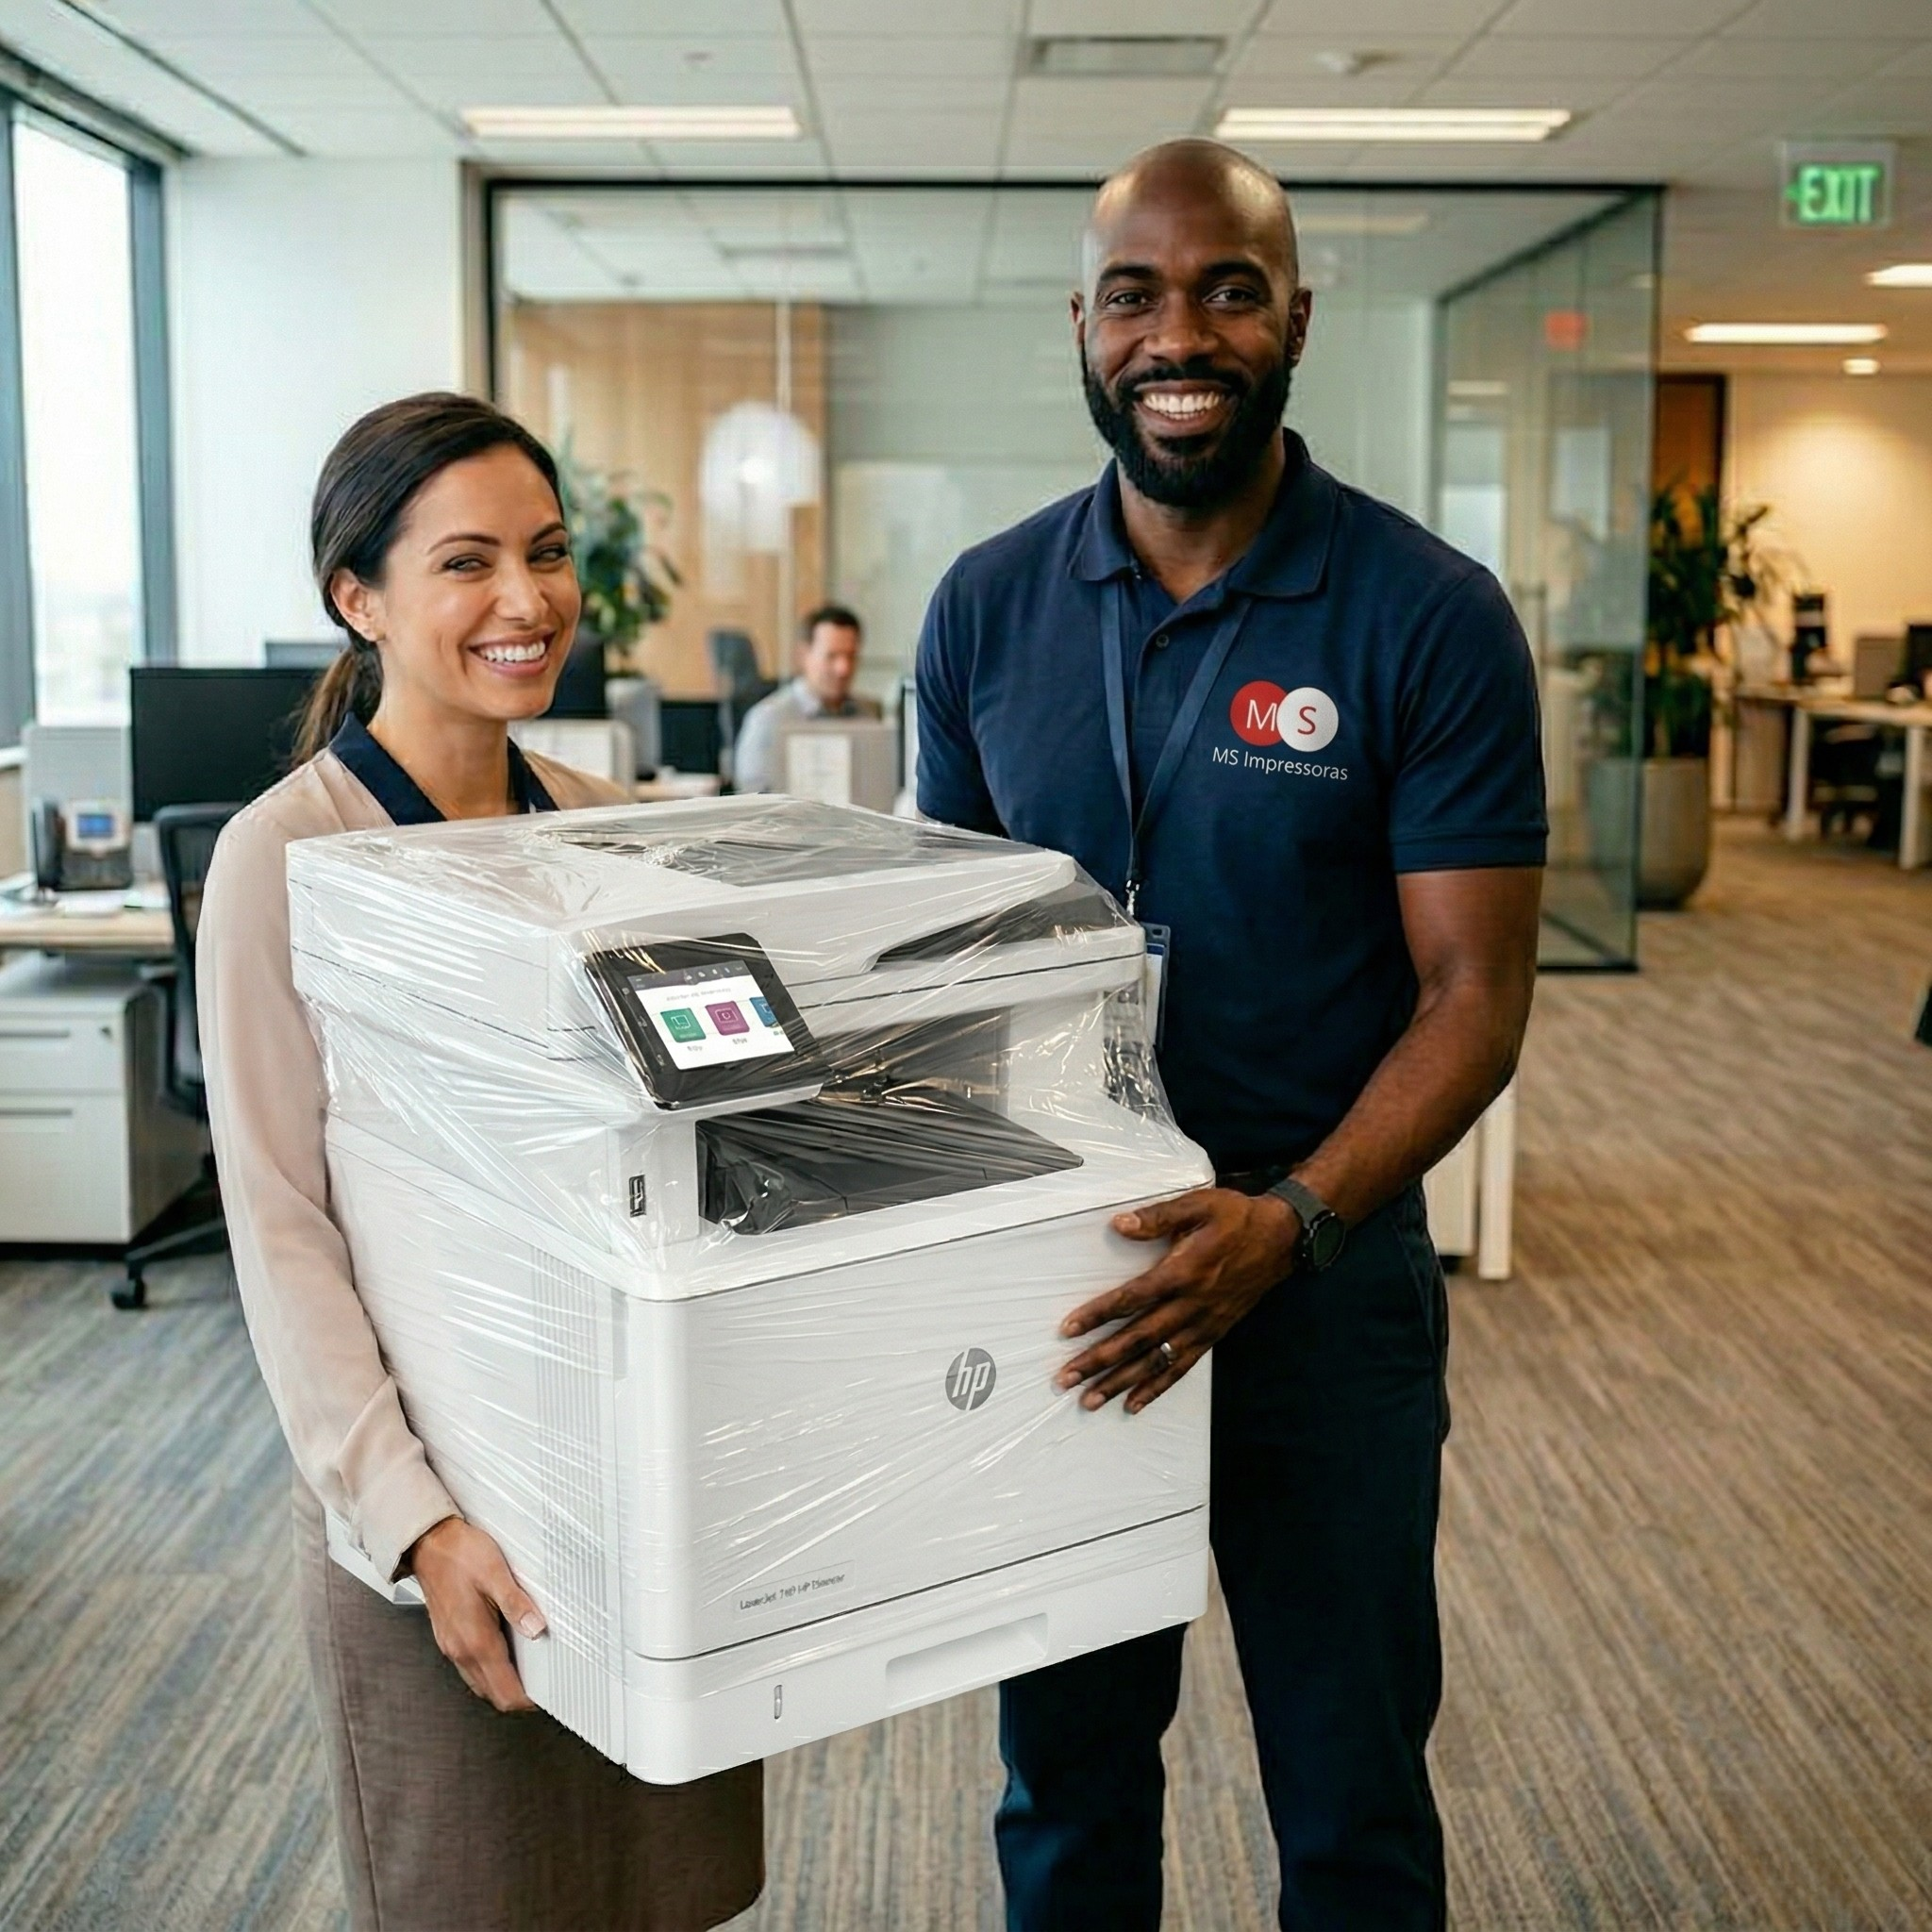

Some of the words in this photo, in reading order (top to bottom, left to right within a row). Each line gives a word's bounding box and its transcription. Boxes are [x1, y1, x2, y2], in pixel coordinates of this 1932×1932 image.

[1799, 167, 1878, 223] EXIT
[1212, 746, 1239, 766] MS
[1243, 751, 1348, 780] Impressoras
